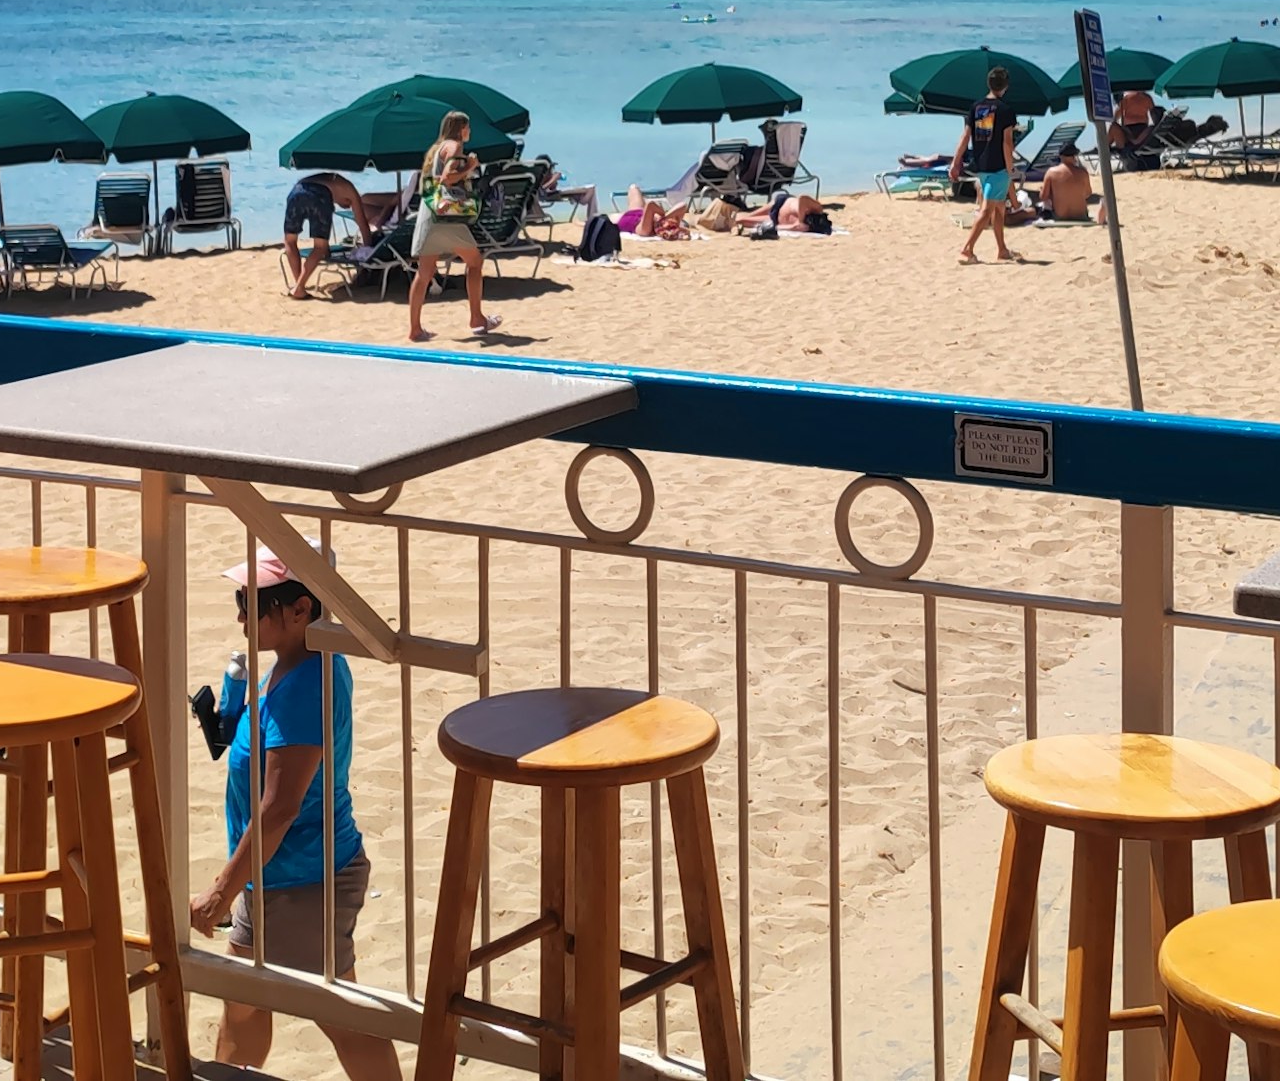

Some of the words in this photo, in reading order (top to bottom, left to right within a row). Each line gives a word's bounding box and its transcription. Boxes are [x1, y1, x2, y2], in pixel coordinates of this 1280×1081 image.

[968, 430, 1002, 442] PLEASE
[1006, 434, 1040, 447] PLEASE
[972, 441, 986, 451] DO
[990, 444, 1009, 454] NOT
[1013, 446, 1037, 456] FEED
[979, 452, 998, 462] THE
[1001, 455, 1031, 465] BIRDS
